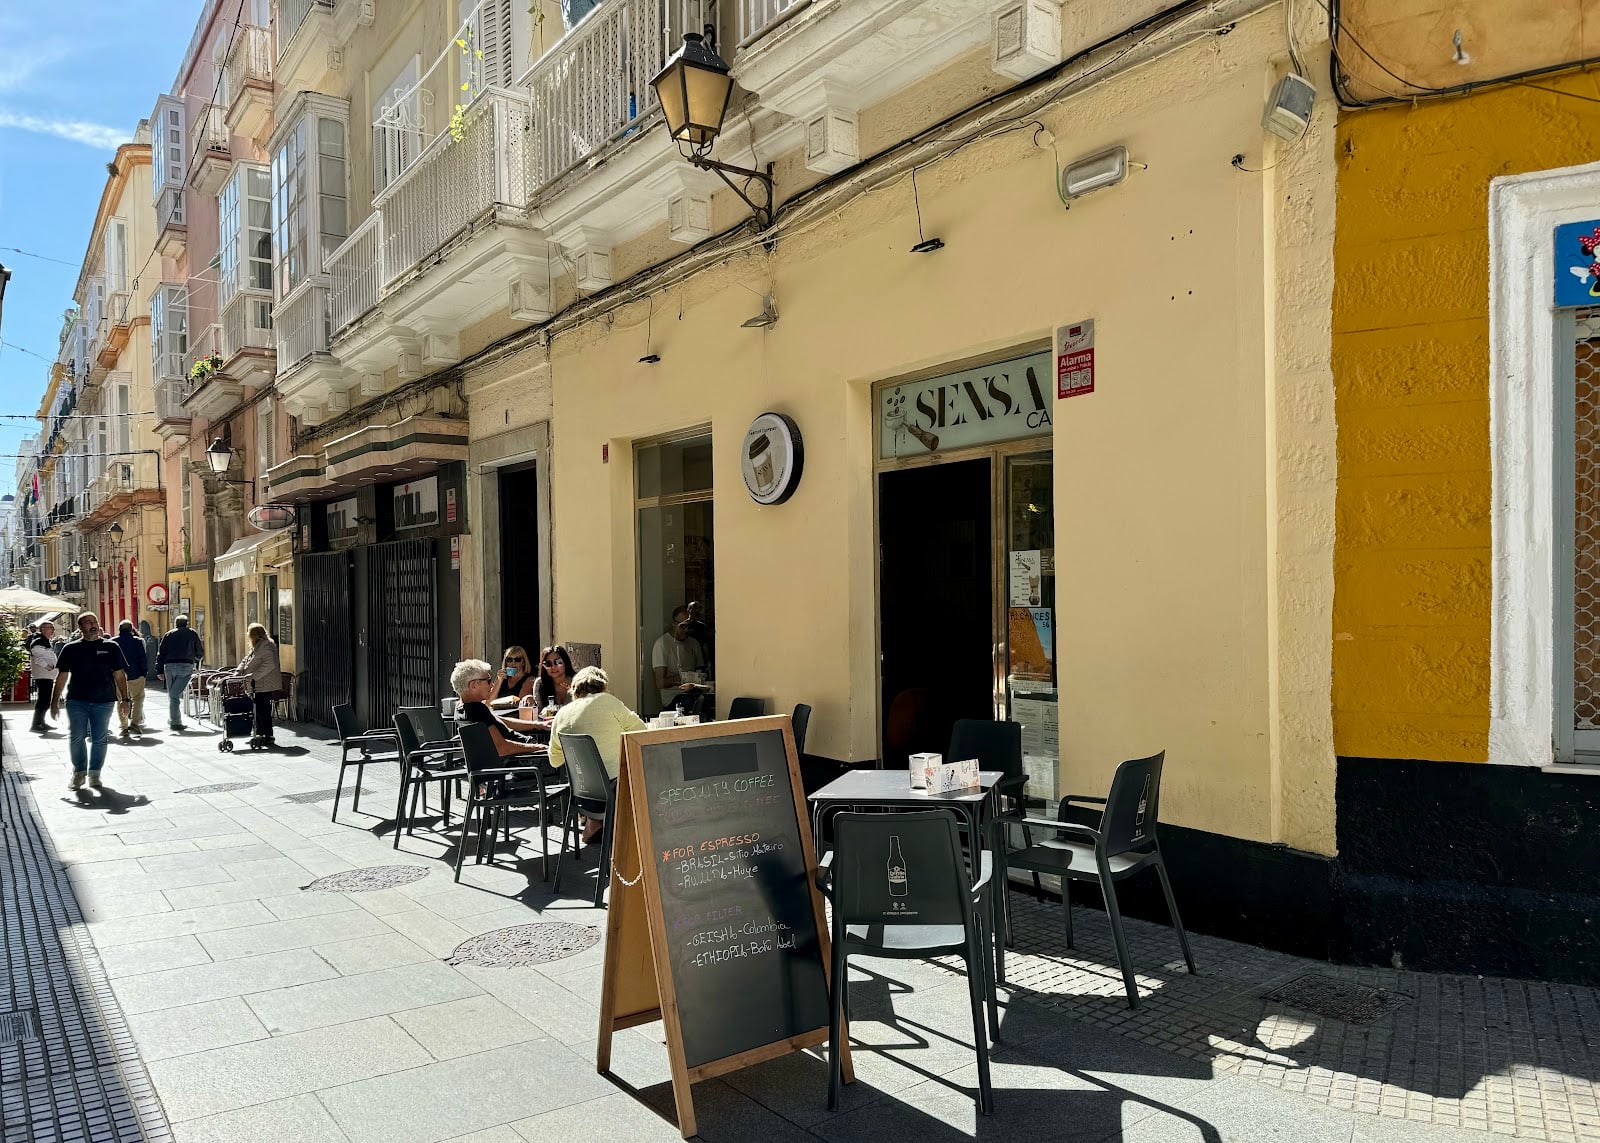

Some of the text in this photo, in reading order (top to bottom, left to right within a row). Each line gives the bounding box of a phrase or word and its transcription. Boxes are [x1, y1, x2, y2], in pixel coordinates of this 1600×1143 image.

[1060, 353, 1091, 368] Alarma
[734, 774, 775, 792] COFFEE
[700, 832, 760, 851] ESPRESSO
